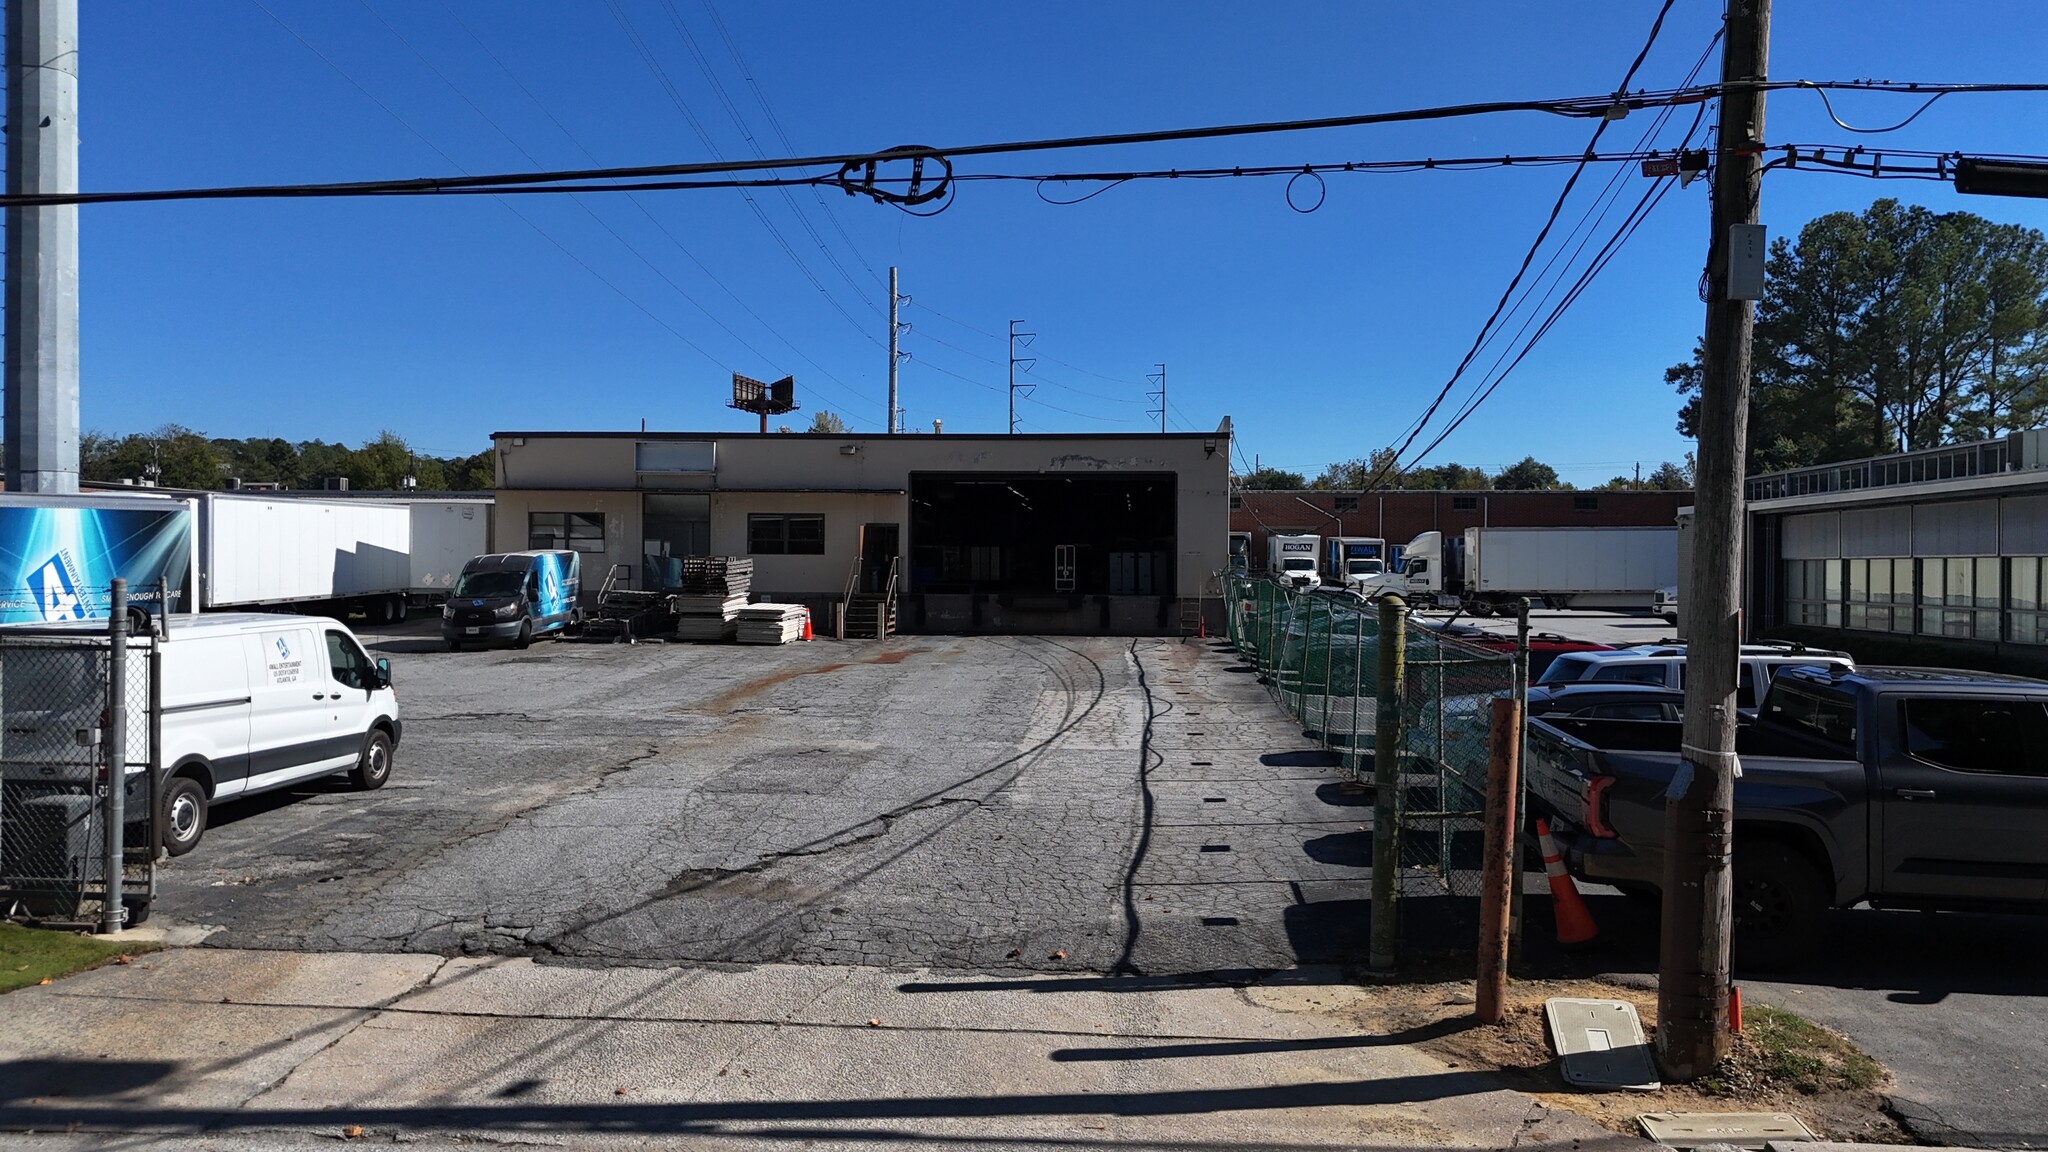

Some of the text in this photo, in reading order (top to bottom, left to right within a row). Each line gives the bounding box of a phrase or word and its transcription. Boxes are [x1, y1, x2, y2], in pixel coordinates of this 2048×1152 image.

[60, 548, 93, 613] ENTERTAINMENT
[126, 592, 154, 601] ENOUGH
[166, 590, 182, 599] CARE
[279, 661, 302, 669] ENTERTAINMENT
